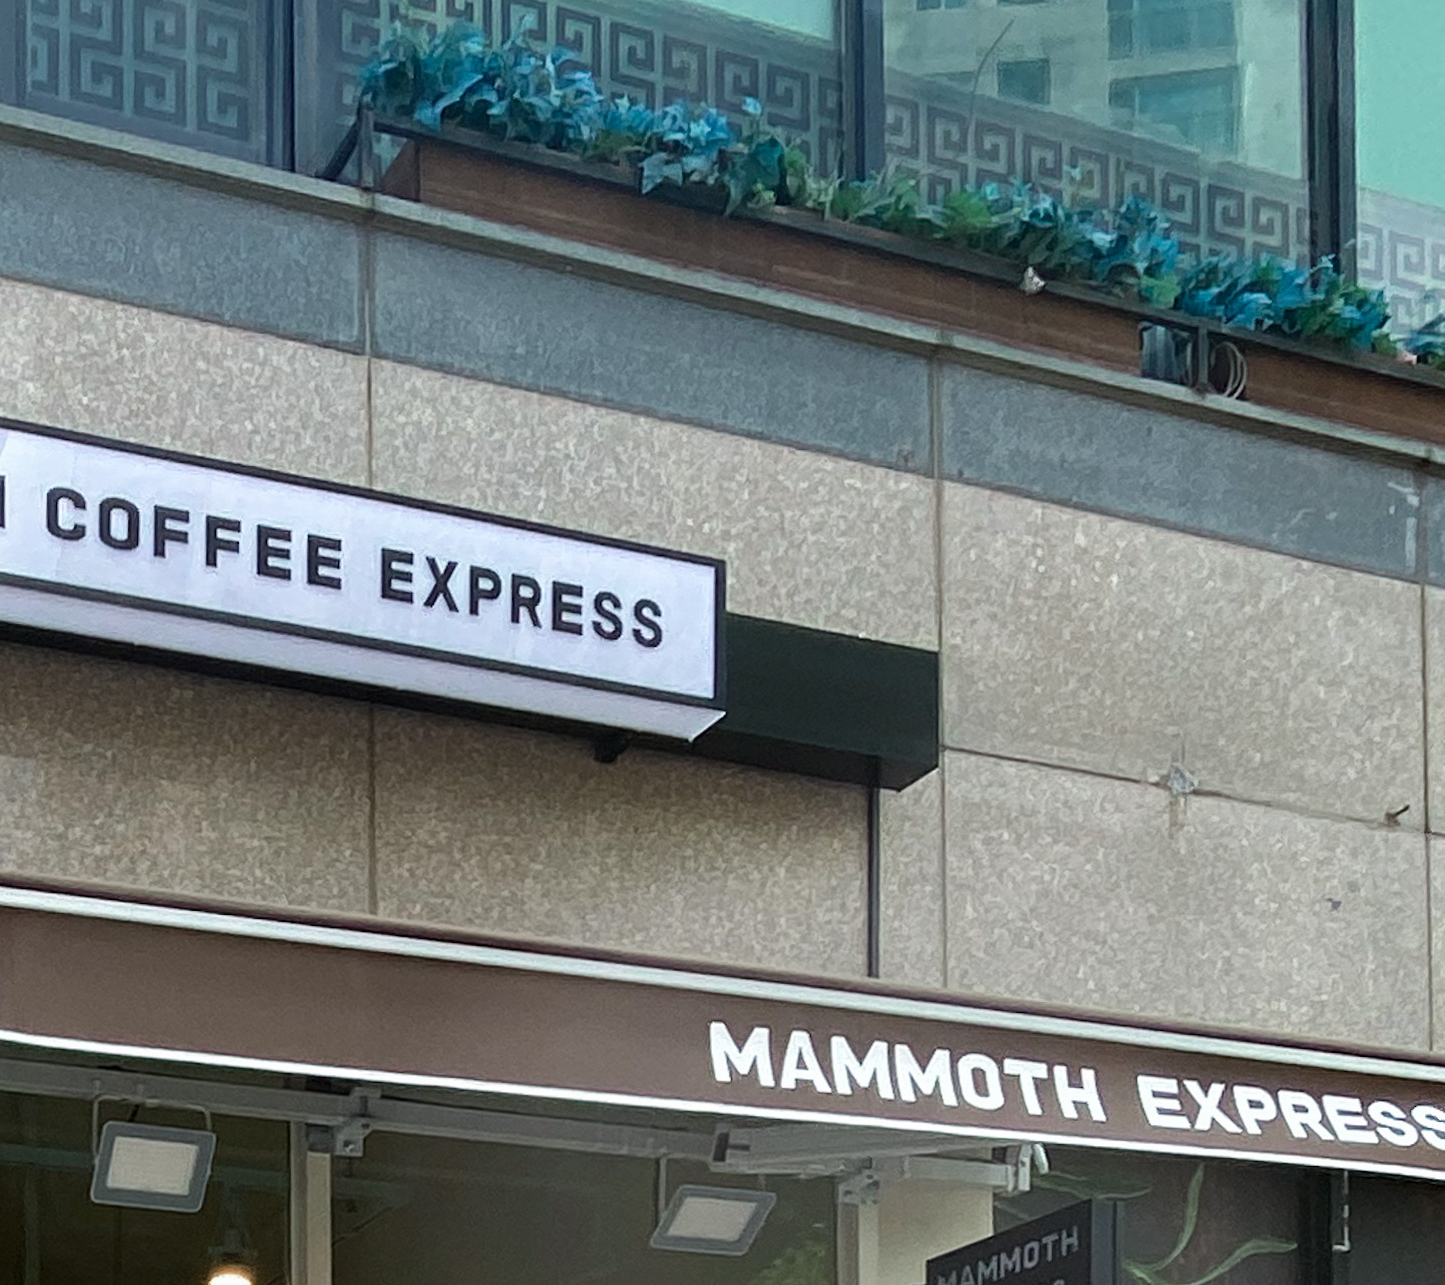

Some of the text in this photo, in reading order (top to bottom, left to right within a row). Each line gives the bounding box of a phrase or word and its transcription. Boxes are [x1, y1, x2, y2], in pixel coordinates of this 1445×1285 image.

[46, 487, 342, 588] COFFEE
[381, 550, 664, 649] EXPRESS
[710, 1021, 1445, 1152] MAMMOTH EXPRESS
